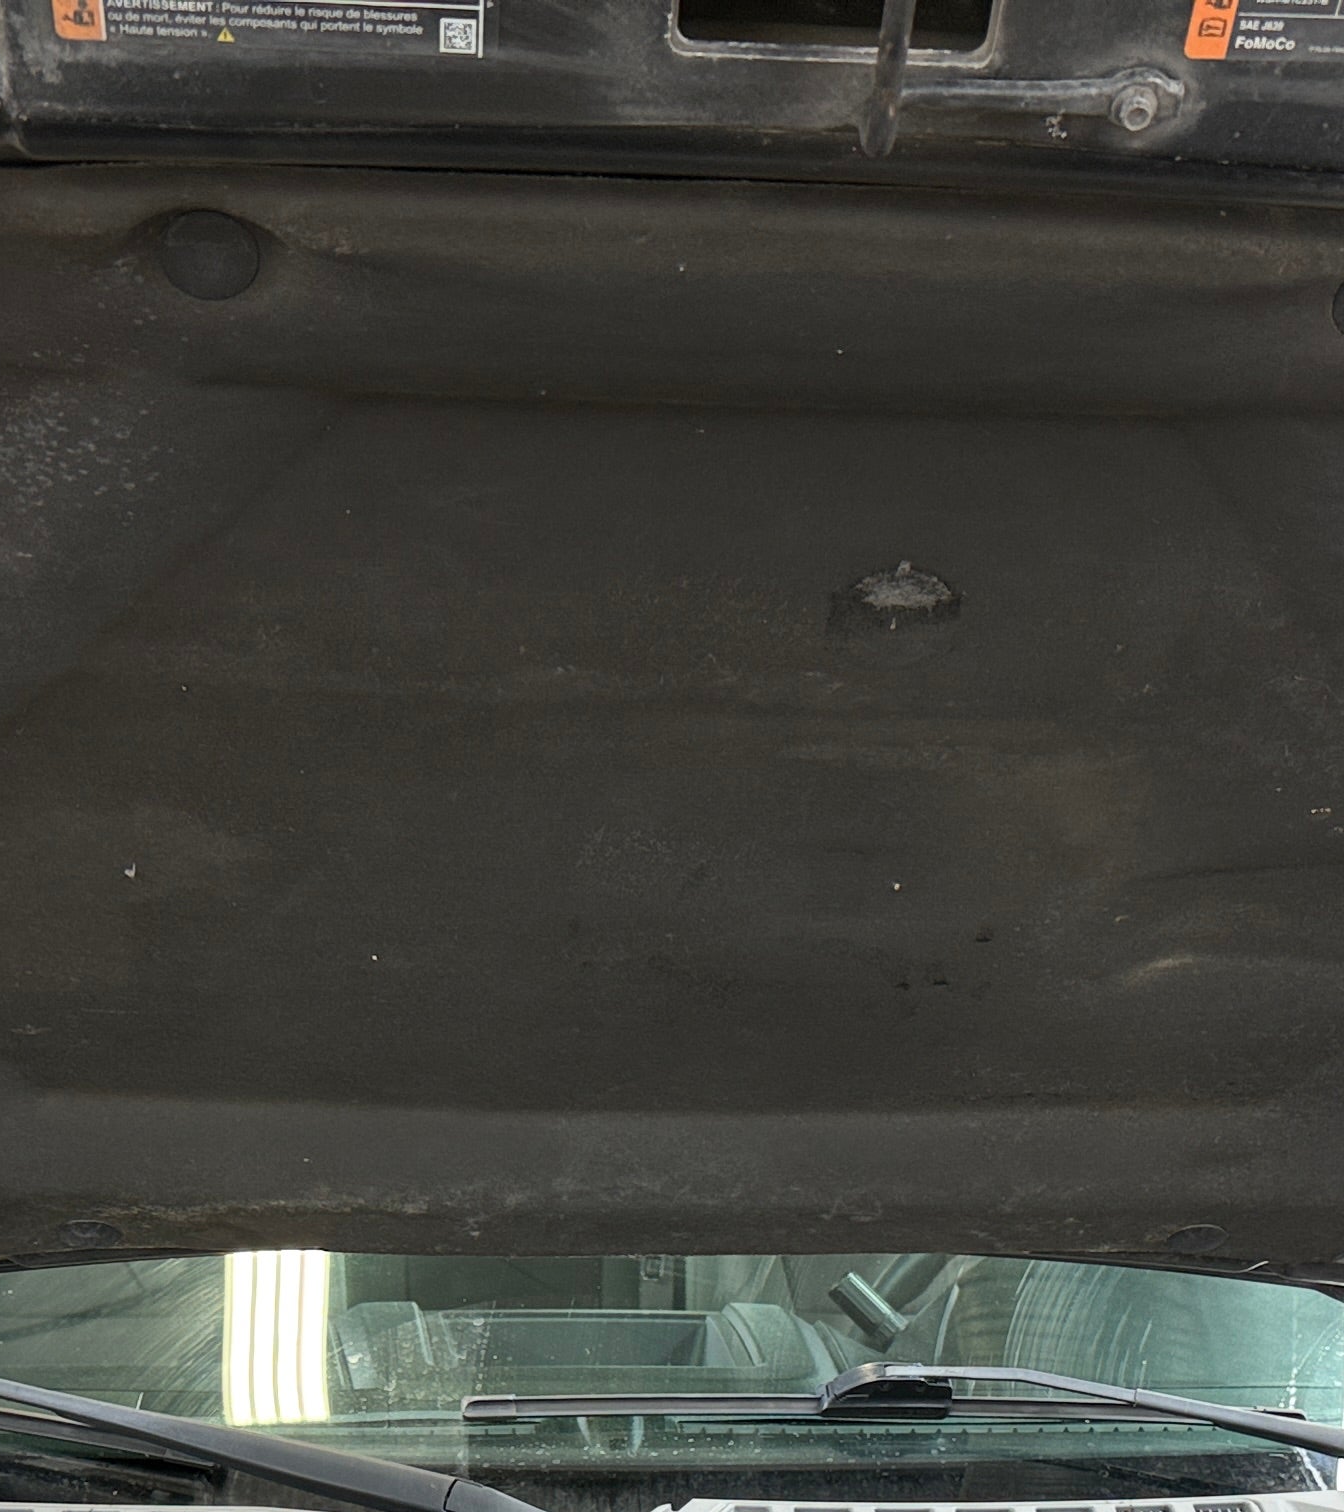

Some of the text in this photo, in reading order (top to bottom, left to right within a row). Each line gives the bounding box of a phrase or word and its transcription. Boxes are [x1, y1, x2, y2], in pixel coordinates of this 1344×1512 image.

[107, 0, 213, 12] AVERTISSEMENT
[222, 3, 249, 14] Pour
[252, 4, 292, 16] réduire
[295, 6, 306, 17] le
[308, 8, 343, 19] risque
[345, 9, 360, 19] de
[363, 9, 418, 21] blessures
[108, 11, 423, 35] ou de mort, éviter les composants qui portent le symbole
[1239, 19, 1259, 31] SAE
[119, 24, 153, 35] Haute
[156, 26, 197, 37] tension
[1234, 36, 1296, 50] FoMoCo
